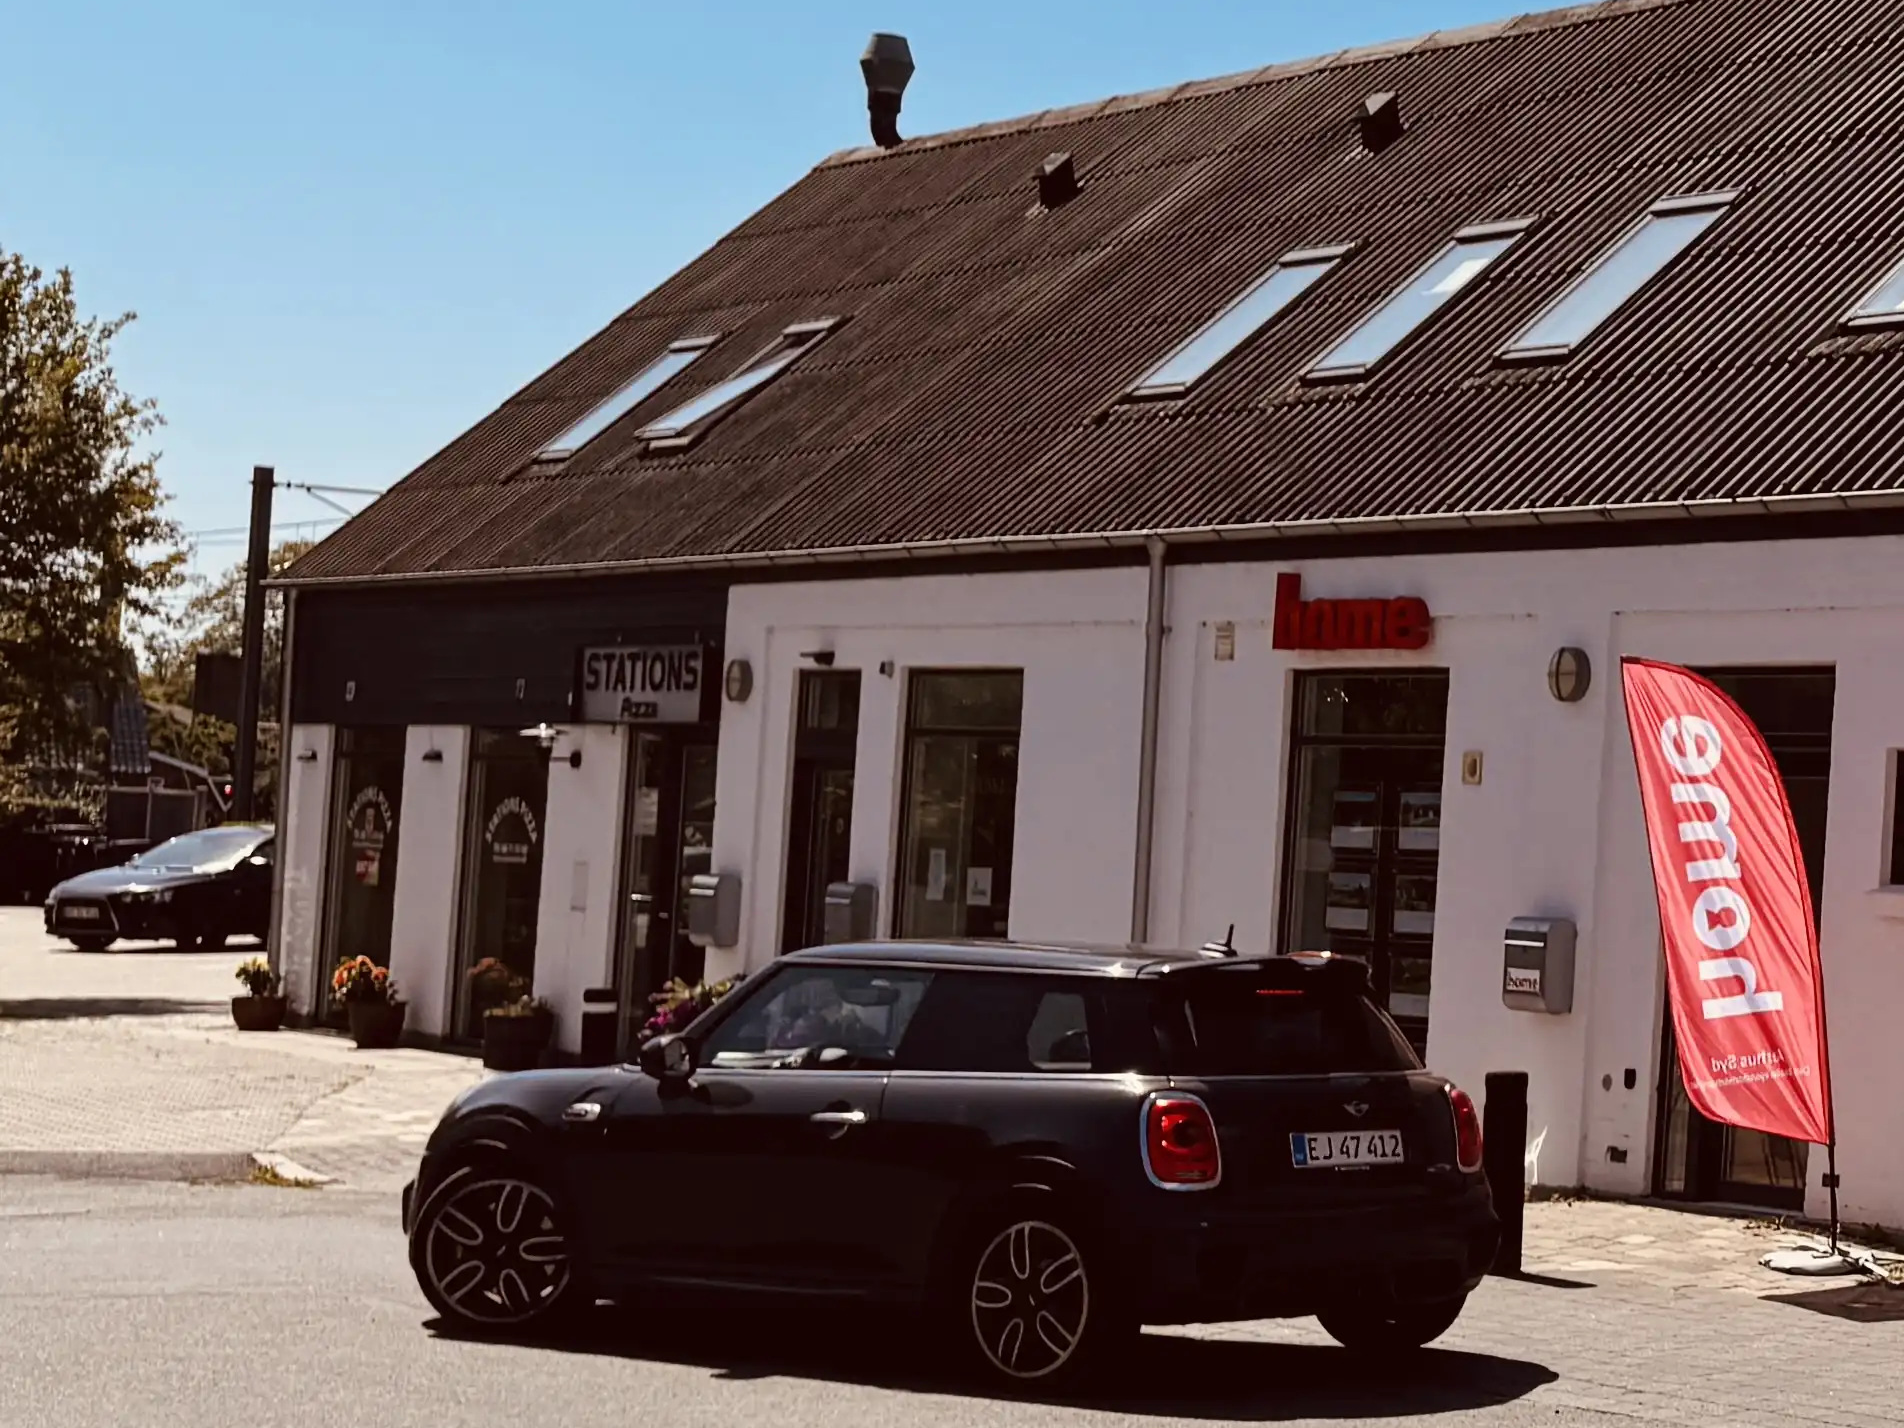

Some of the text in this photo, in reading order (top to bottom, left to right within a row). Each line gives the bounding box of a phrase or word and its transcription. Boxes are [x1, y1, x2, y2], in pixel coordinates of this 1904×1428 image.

[1272, 572, 1430, 650] home
[585, 650, 699, 692] STATIONS
[1307, 1134, 1401, 1161] EJ 47 412
